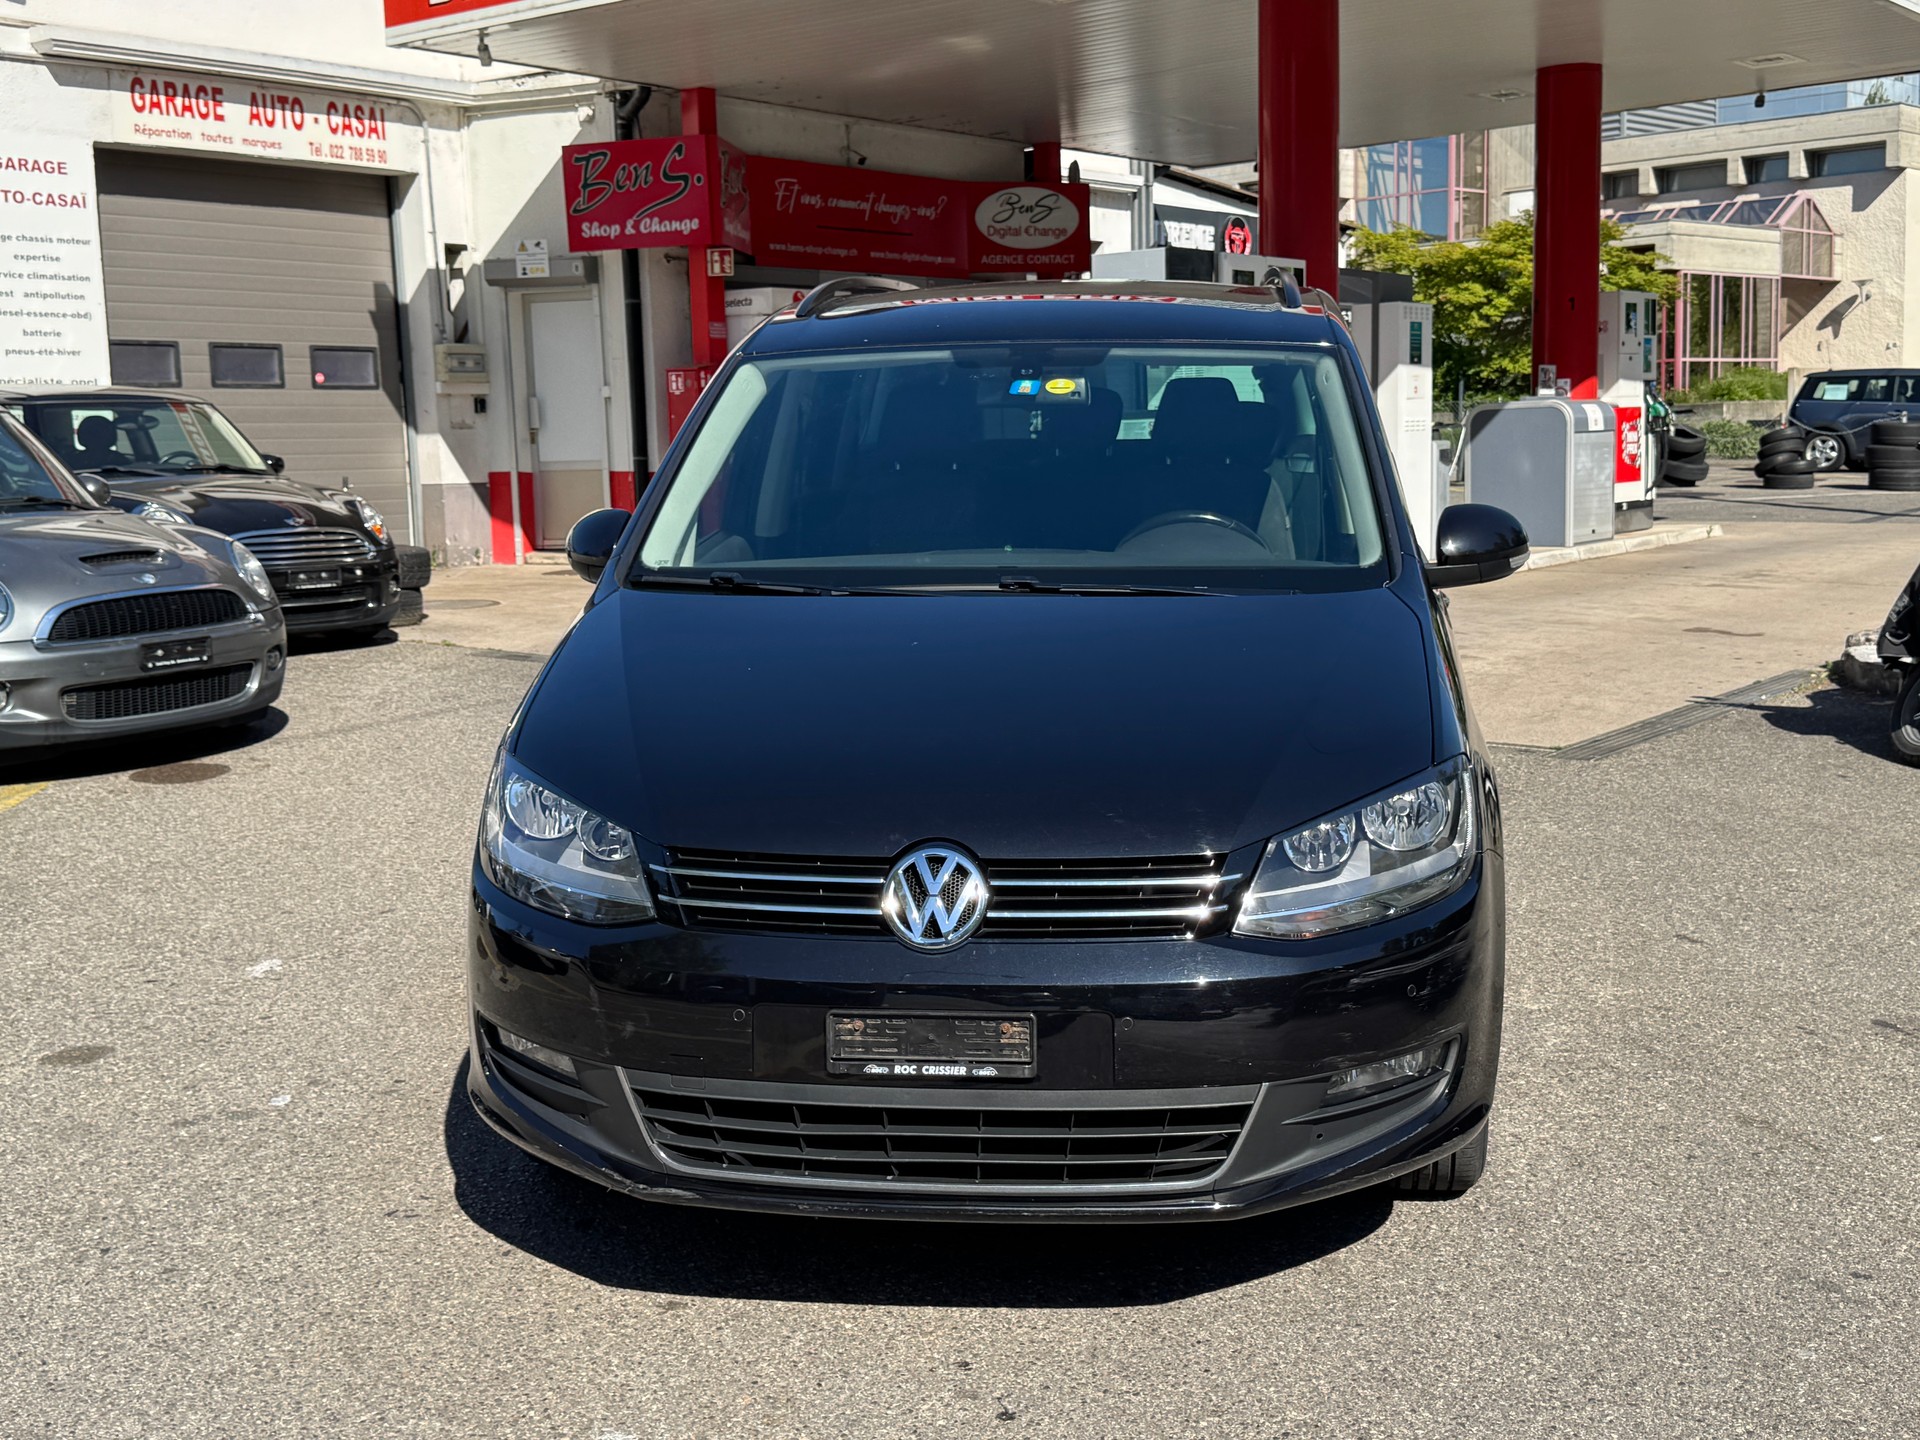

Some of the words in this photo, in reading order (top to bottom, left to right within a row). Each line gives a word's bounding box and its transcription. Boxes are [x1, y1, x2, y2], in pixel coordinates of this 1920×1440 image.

[130, 76, 226, 122] GARAGE
[248, 91, 304, 131] AUTO
[133, 123, 193, 140] Réparation
[201, 132, 234, 145] toutes
[242, 138, 283, 151] marques
[0, 156, 69, 176] ARAGE
[570, 149, 654, 216] Ben
[581, 220, 621, 240] Shop
[624, 219, 636, 235] &
[639, 217, 700, 236] Change
[987, 224, 1022, 240] Digital
[15, 233, 54, 244] chassis
[56, 236, 92, 246] moteur
[13, 252, 62, 264] expertise
[981, 254, 1025, 265] AGENCE
[1026, 254, 1075, 265] CONTACT
[26, 271, 91, 282] climatisation
[23, 290, 86, 301] antipollution
[22, 328, 63, 338] batterie
[893, 1064, 917, 1074] ROC
[921, 1065, 967, 1076] CRISSIER
